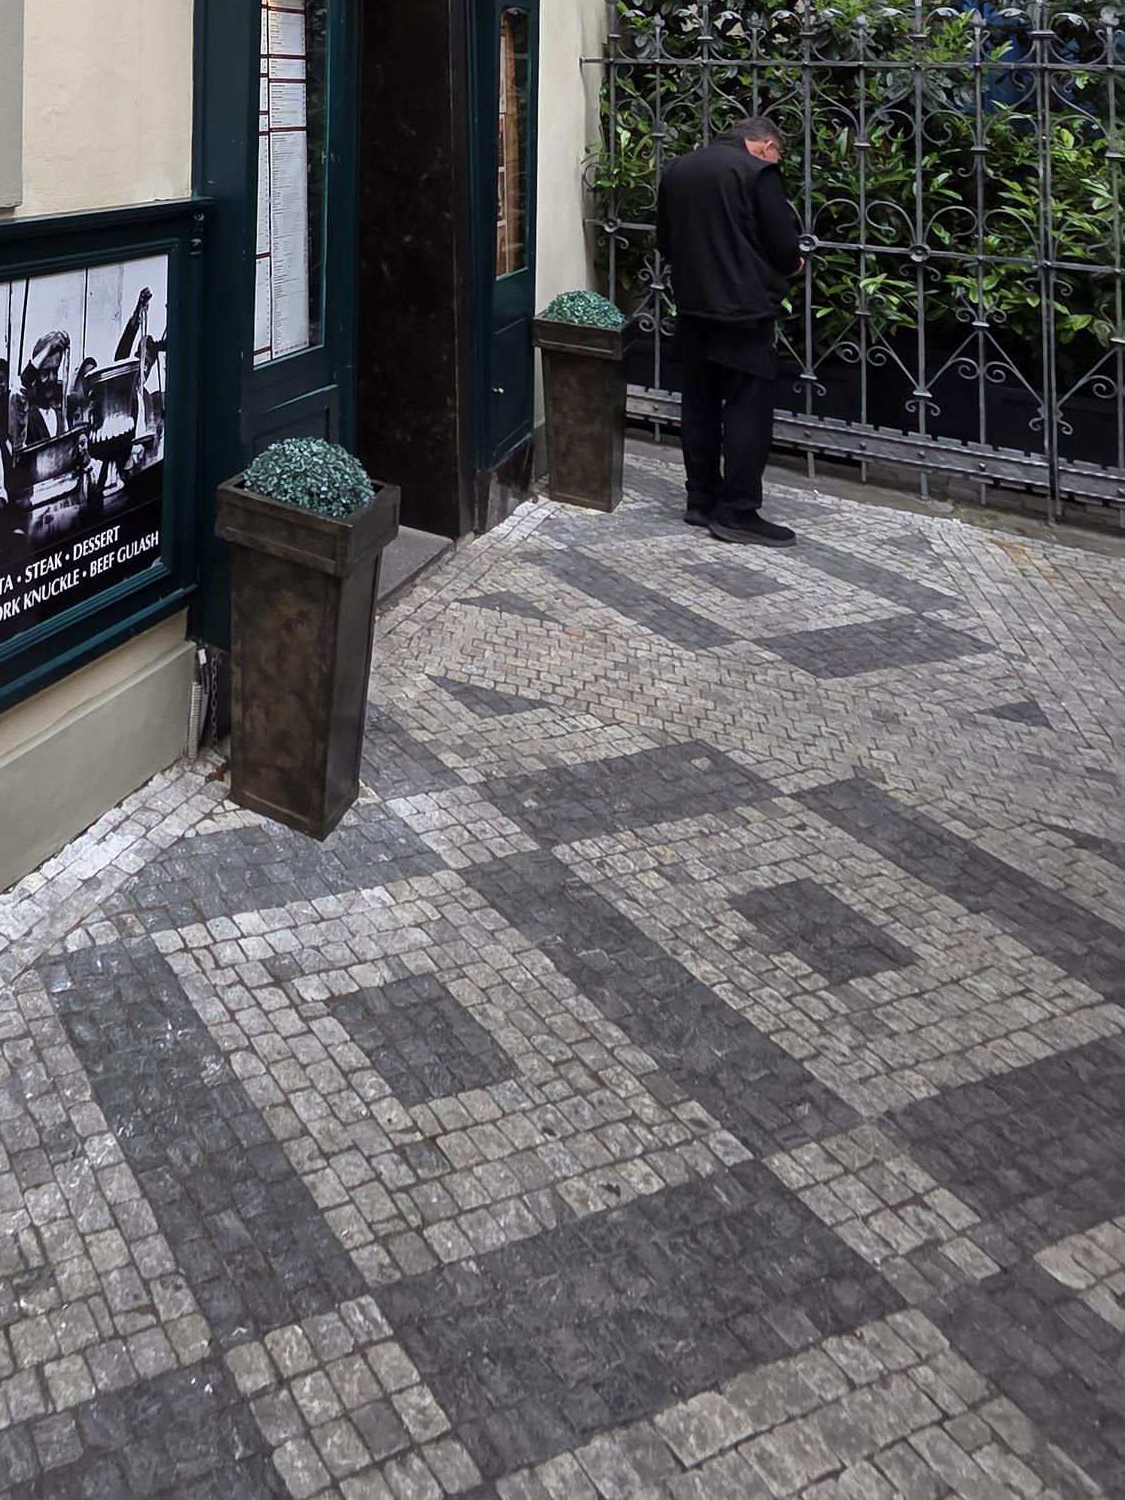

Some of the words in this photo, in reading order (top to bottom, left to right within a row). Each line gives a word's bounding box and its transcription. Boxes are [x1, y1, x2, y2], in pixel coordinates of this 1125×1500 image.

[23, 568, 80, 611] KNUCKLE
[89, 552, 116, 578] BEEF
[117, 530, 160, 563] GULASH
[25, 551, 63, 583] STEAK
[72, 526, 121, 562] DESSERT
